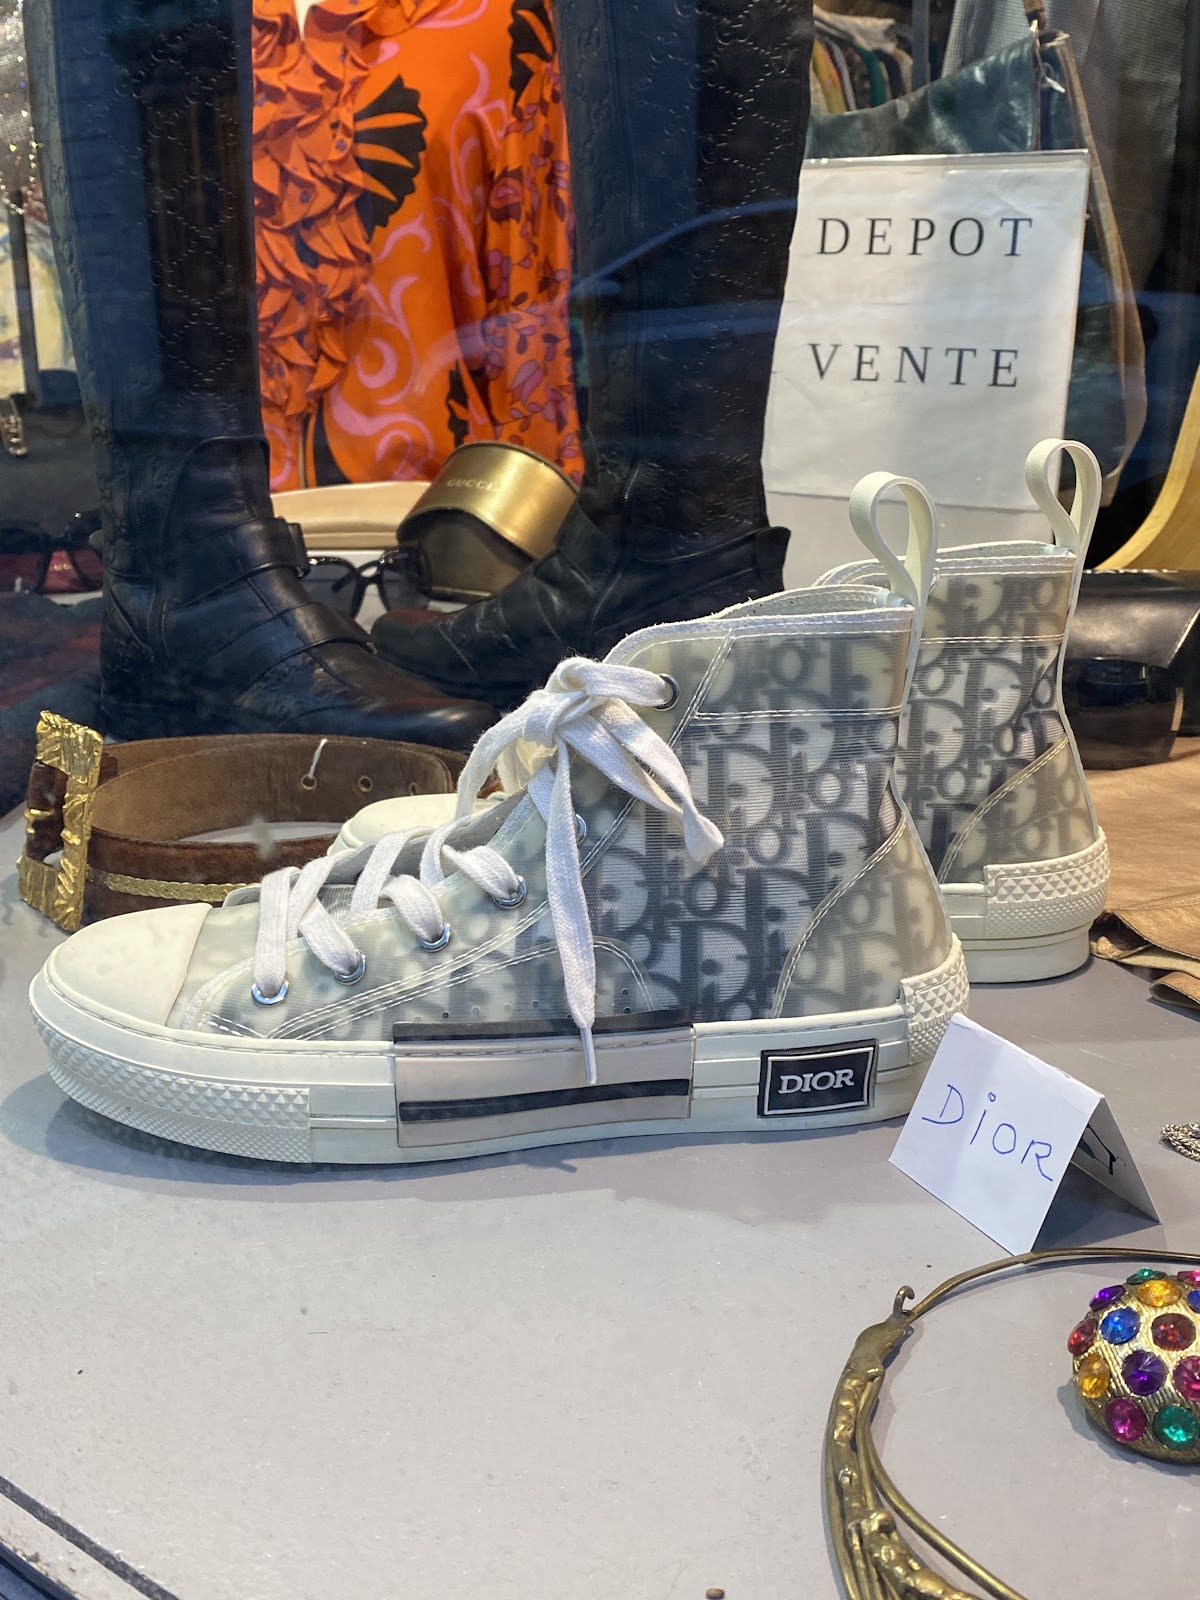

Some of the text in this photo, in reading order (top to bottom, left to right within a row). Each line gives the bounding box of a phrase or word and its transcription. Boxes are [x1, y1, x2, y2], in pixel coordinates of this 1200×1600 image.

[817, 217, 1033, 257] DEPOT
[808, 343, 1018, 388] VENTE
[447, 479, 493, 491] GUCCI
[778, 1068, 854, 1094] DIOR
